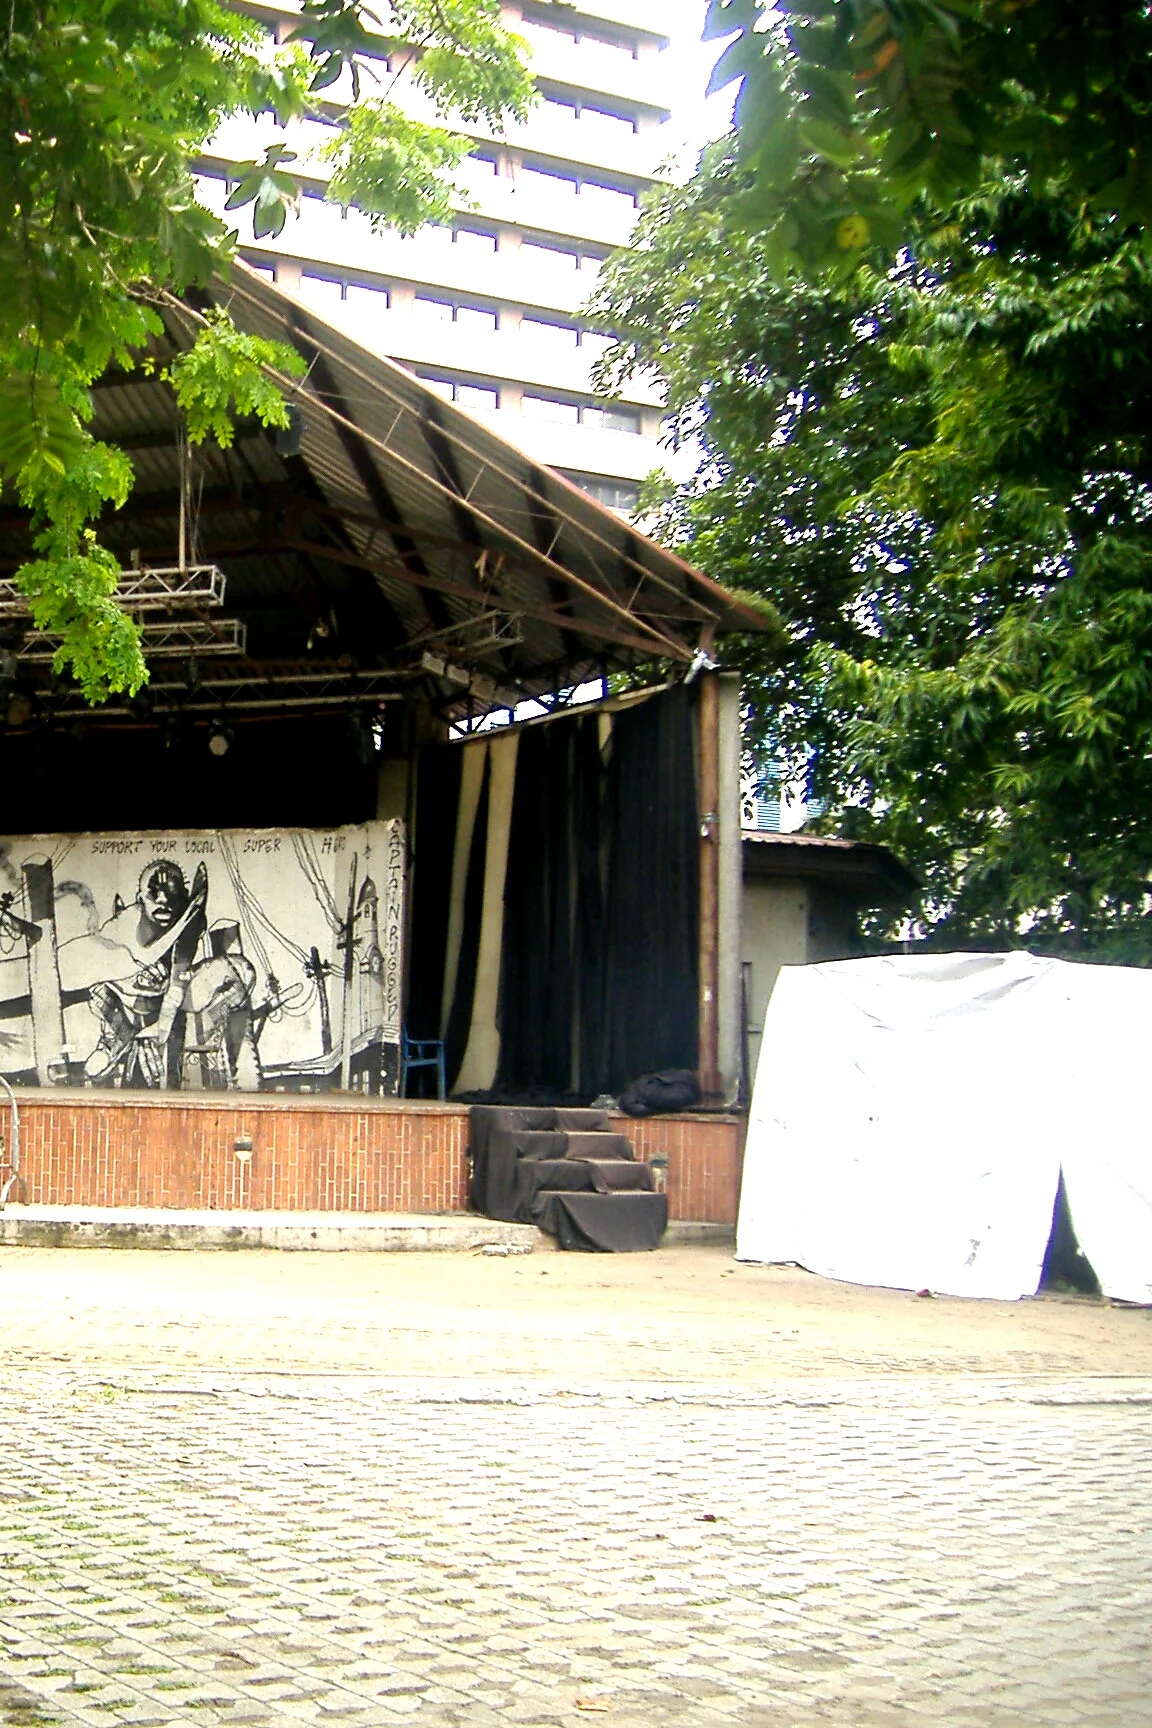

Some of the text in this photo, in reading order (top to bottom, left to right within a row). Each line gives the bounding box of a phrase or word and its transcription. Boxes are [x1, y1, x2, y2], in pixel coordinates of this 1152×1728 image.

[91, 840, 143, 854] SUPPORT
[150, 840, 177, 852] YOUR
[185, 840, 215, 854] LOCAL
[243, 838, 282, 854] SUPER
